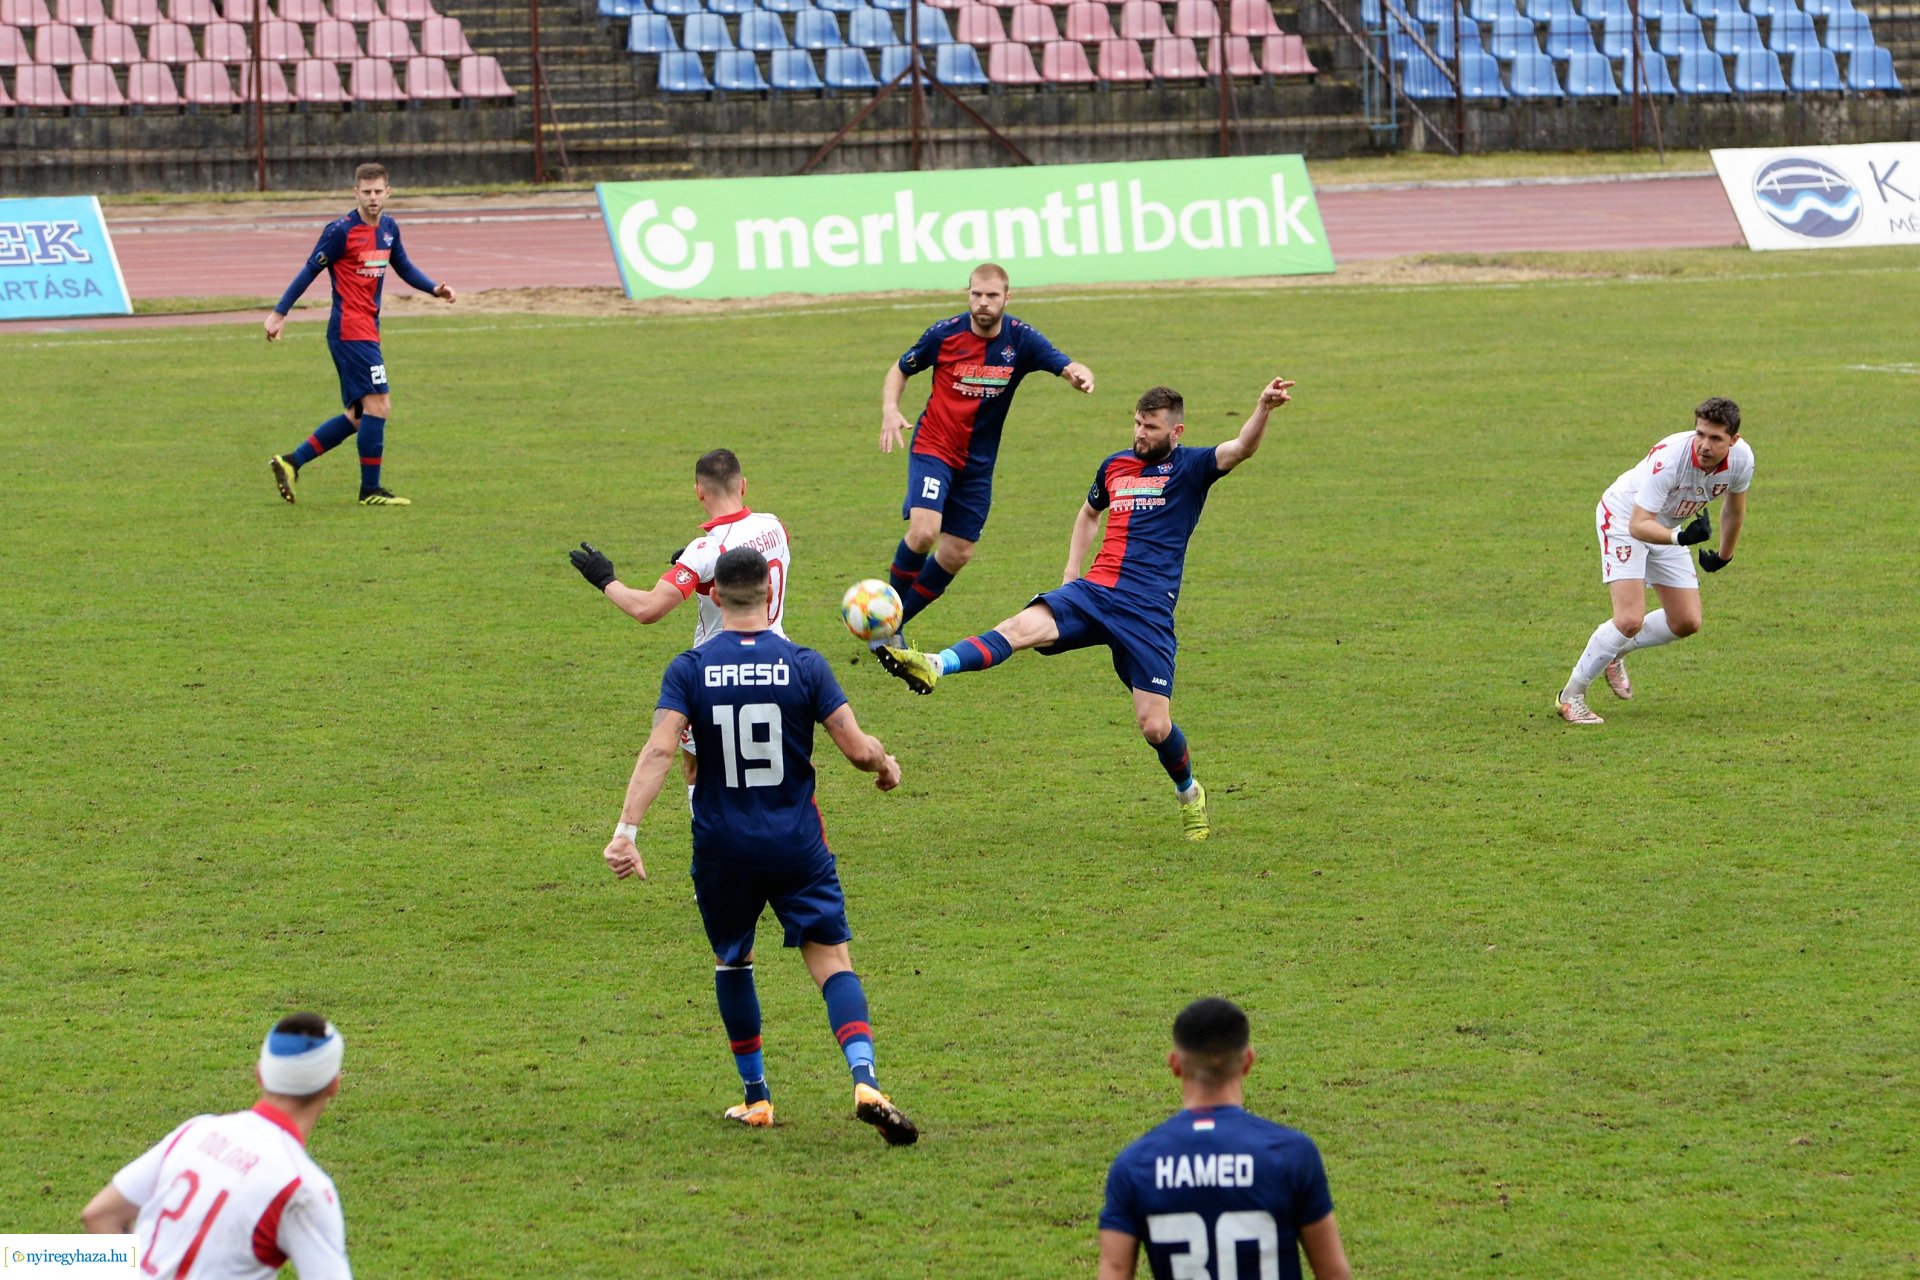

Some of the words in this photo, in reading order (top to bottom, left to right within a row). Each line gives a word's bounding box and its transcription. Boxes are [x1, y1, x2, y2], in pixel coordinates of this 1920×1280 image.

[1868, 159, 1920, 203] K
[735, 173, 1316, 271] merkantilbank
[922, 476, 941, 500] 15
[704, 658, 790, 687] GRESÓ
[1152, 677, 1167, 686] JAKO
[712, 703, 784, 788] 19
[1156, 1154, 1254, 1189] HAMED
[140, 1169, 229, 1280] 21
[1147, 1210, 1280, 1280] 30
